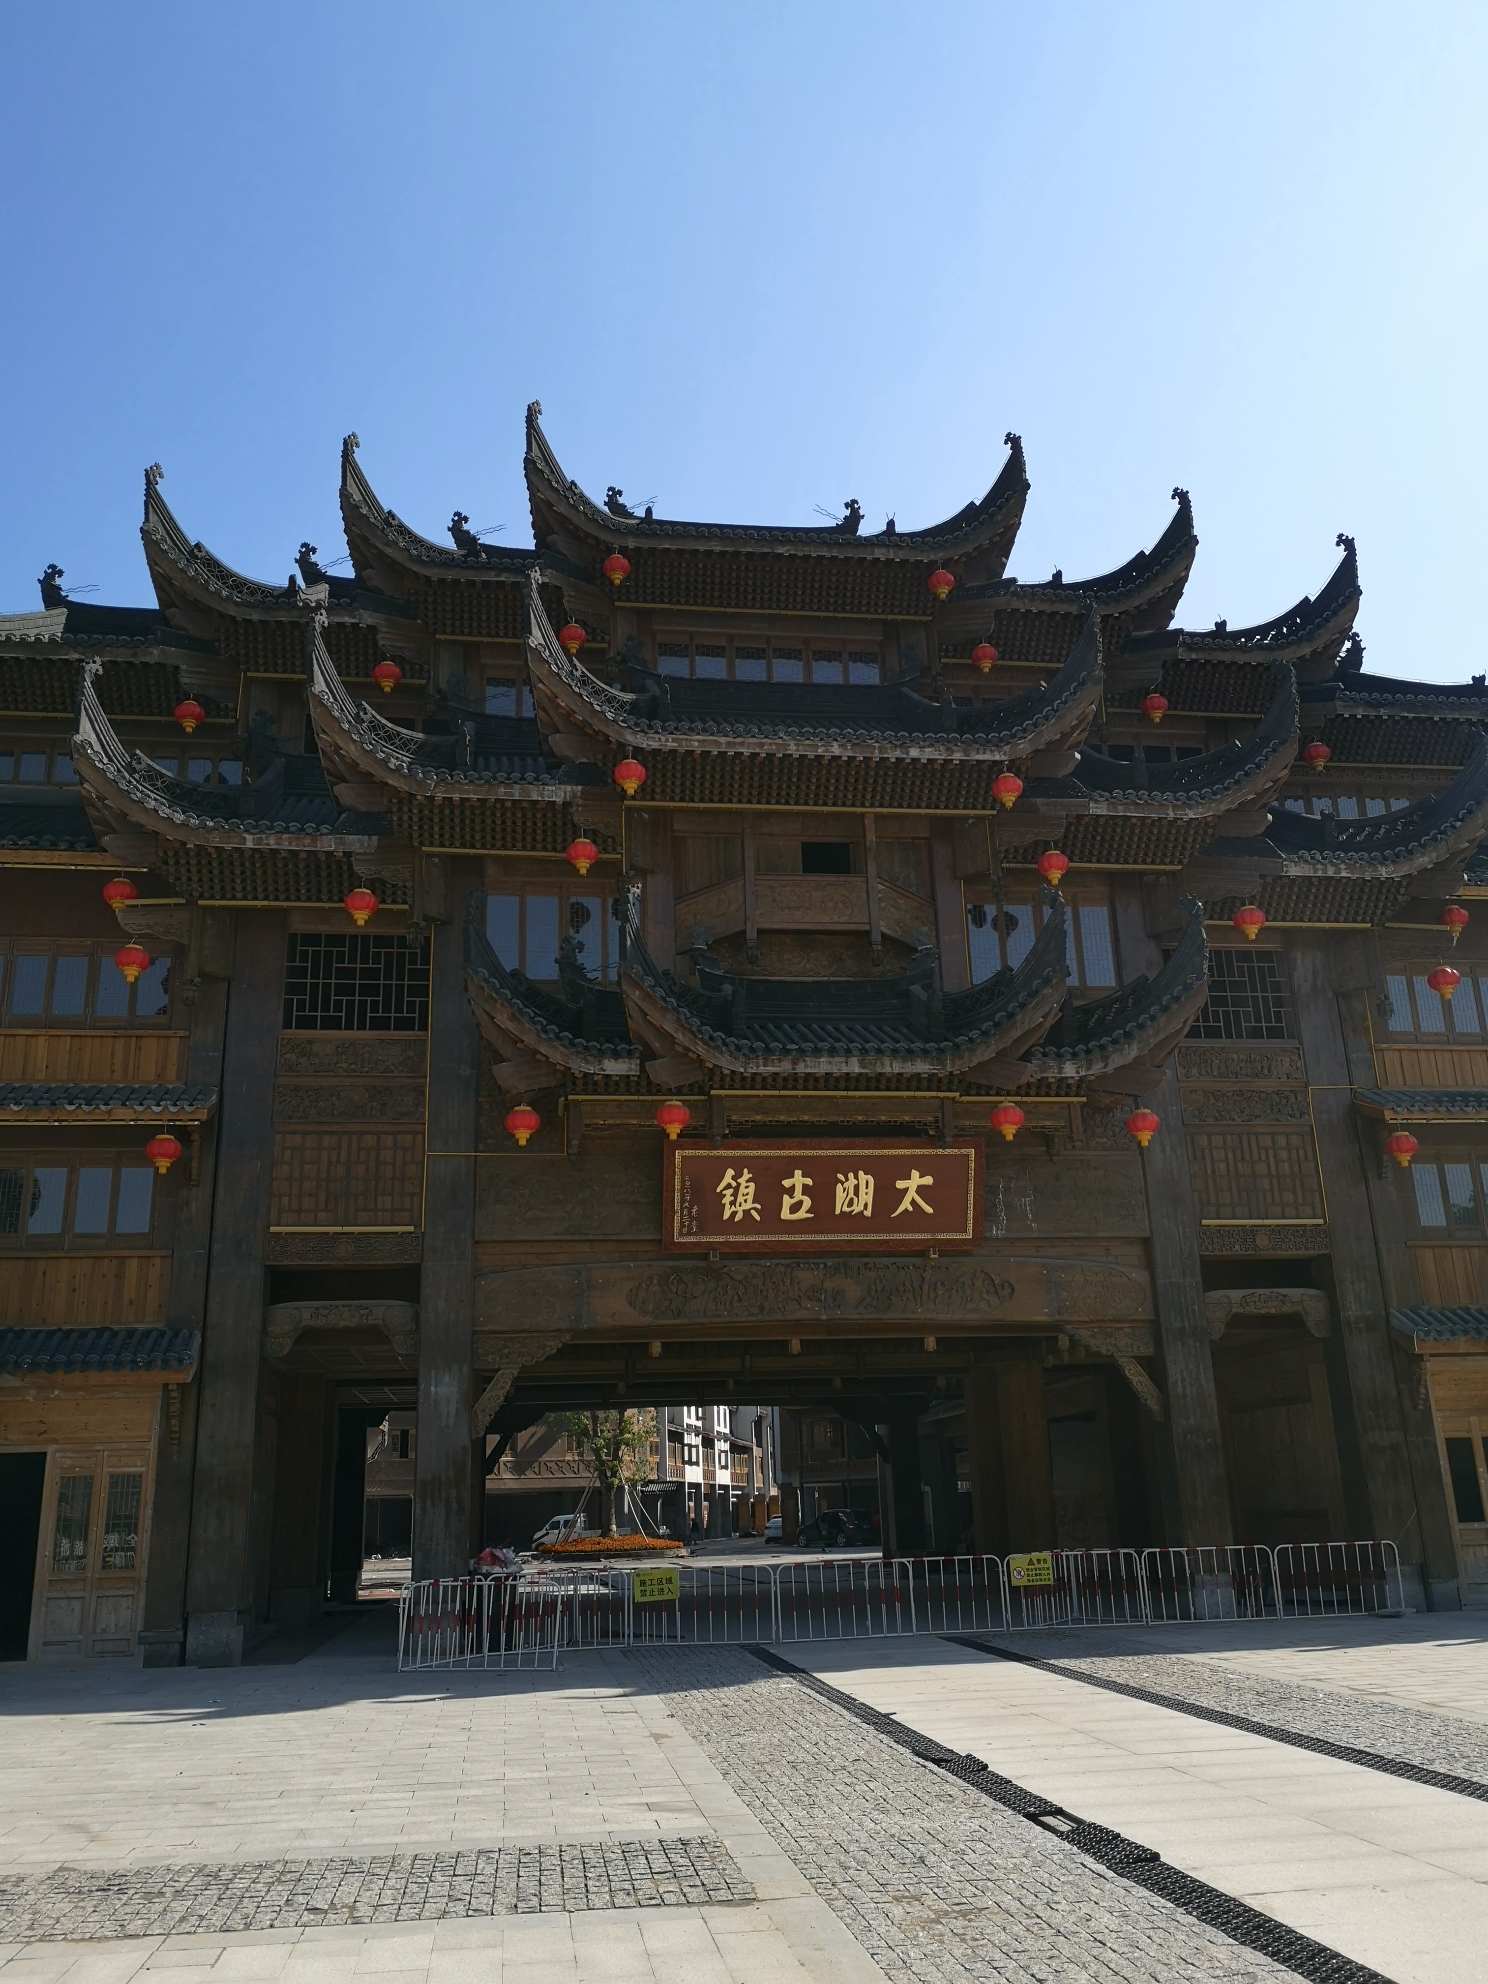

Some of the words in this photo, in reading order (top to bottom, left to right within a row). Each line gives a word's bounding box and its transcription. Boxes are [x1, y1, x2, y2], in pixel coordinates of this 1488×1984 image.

[638, 1576, 674, 1588] 施工区域
[639, 1587, 674, 1598] 禁止进入
